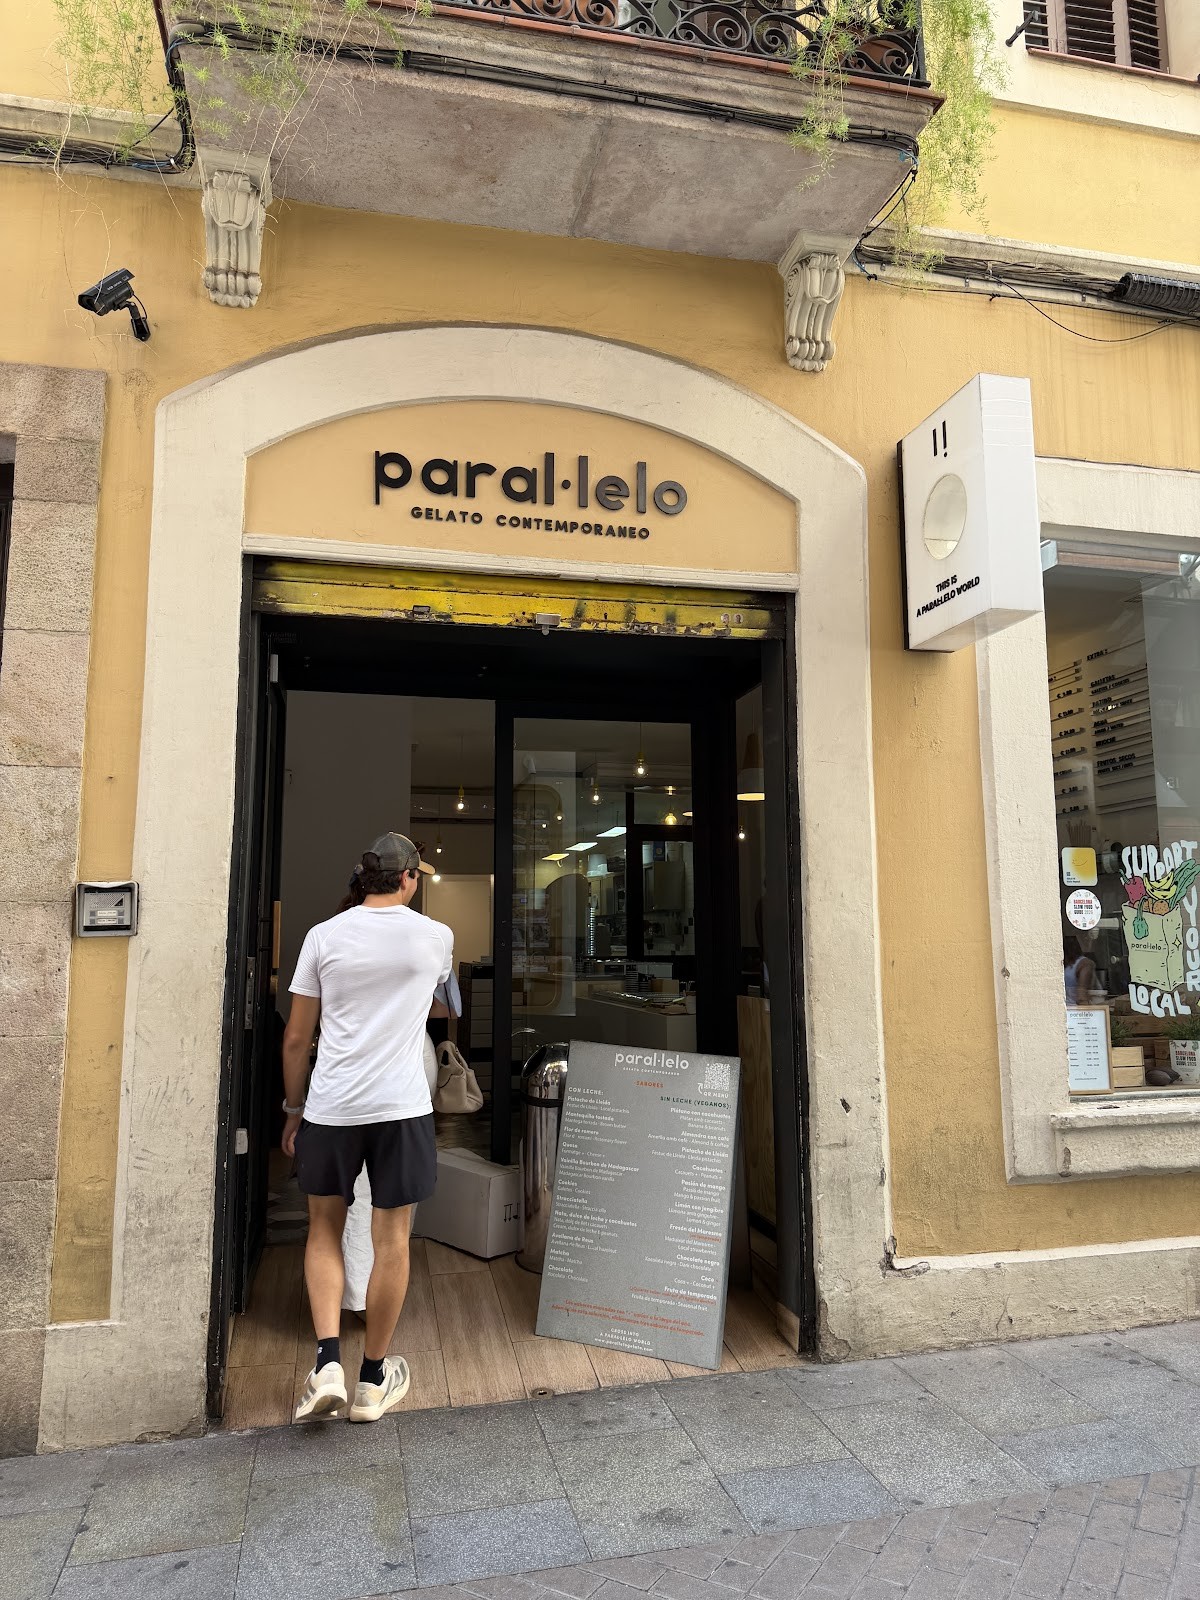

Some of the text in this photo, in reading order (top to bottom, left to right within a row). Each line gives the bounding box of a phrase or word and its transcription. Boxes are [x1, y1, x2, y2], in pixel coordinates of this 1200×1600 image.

[374, 450, 688, 515] paral·lelo
[411, 506, 650, 539] GELATO CONTEMPORANEO
[935, 574, 958, 593] THIS IS
[916, 607, 922, 618] A
[955, 576, 980, 596] WORLD
[1118, 752, 1136, 761] SECOS
[1183, 885, 1200, 992] YOUR
[1128, 984, 1191, 1018] LOCAL
[614, 1052, 690, 1070] paral·lelo
[565, 1111, 594, 1119] Mantequilla
[701, 1110, 730, 1119] cacahuetes
[581, 1127, 599, 1135] romero
[681, 1130, 706, 1139] Almendra
[681, 1146, 703, 1154] Pistacho
[560, 1156, 578, 1164] Vainilla
[579, 1159, 599, 1167] Bourbon
[607, 1162, 639, 1173] Madagascar
[691, 1163, 723, 1173] Cacahuetes
[558, 1178, 577, 1186] Cookies
[706, 1183, 725, 1192] mango
[556, 1194, 587, 1203] Stracciatella
[674, 1201, 690, 1209] Limón
[701, 1205, 723, 1214] jengibre
[554, 1209, 568, 1217] Nata,
[608, 1217, 637, 1226] cacahuetes
[551, 1232, 573, 1240] Avellana
[697, 1227, 722, 1237] Maresme
[550, 1248, 569, 1256] Matcha
[676, 1253, 703, 1263] Chocolate
[548, 1264, 573, 1273] Chocolate
[692, 1280, 711, 1288] Coconut
[664, 1285, 678, 1293] Fruta
[687, 1289, 716, 1300] temporada
[650, 1296, 675, 1306] temporada
[677, 1300, 697, 1310] Seasonal
